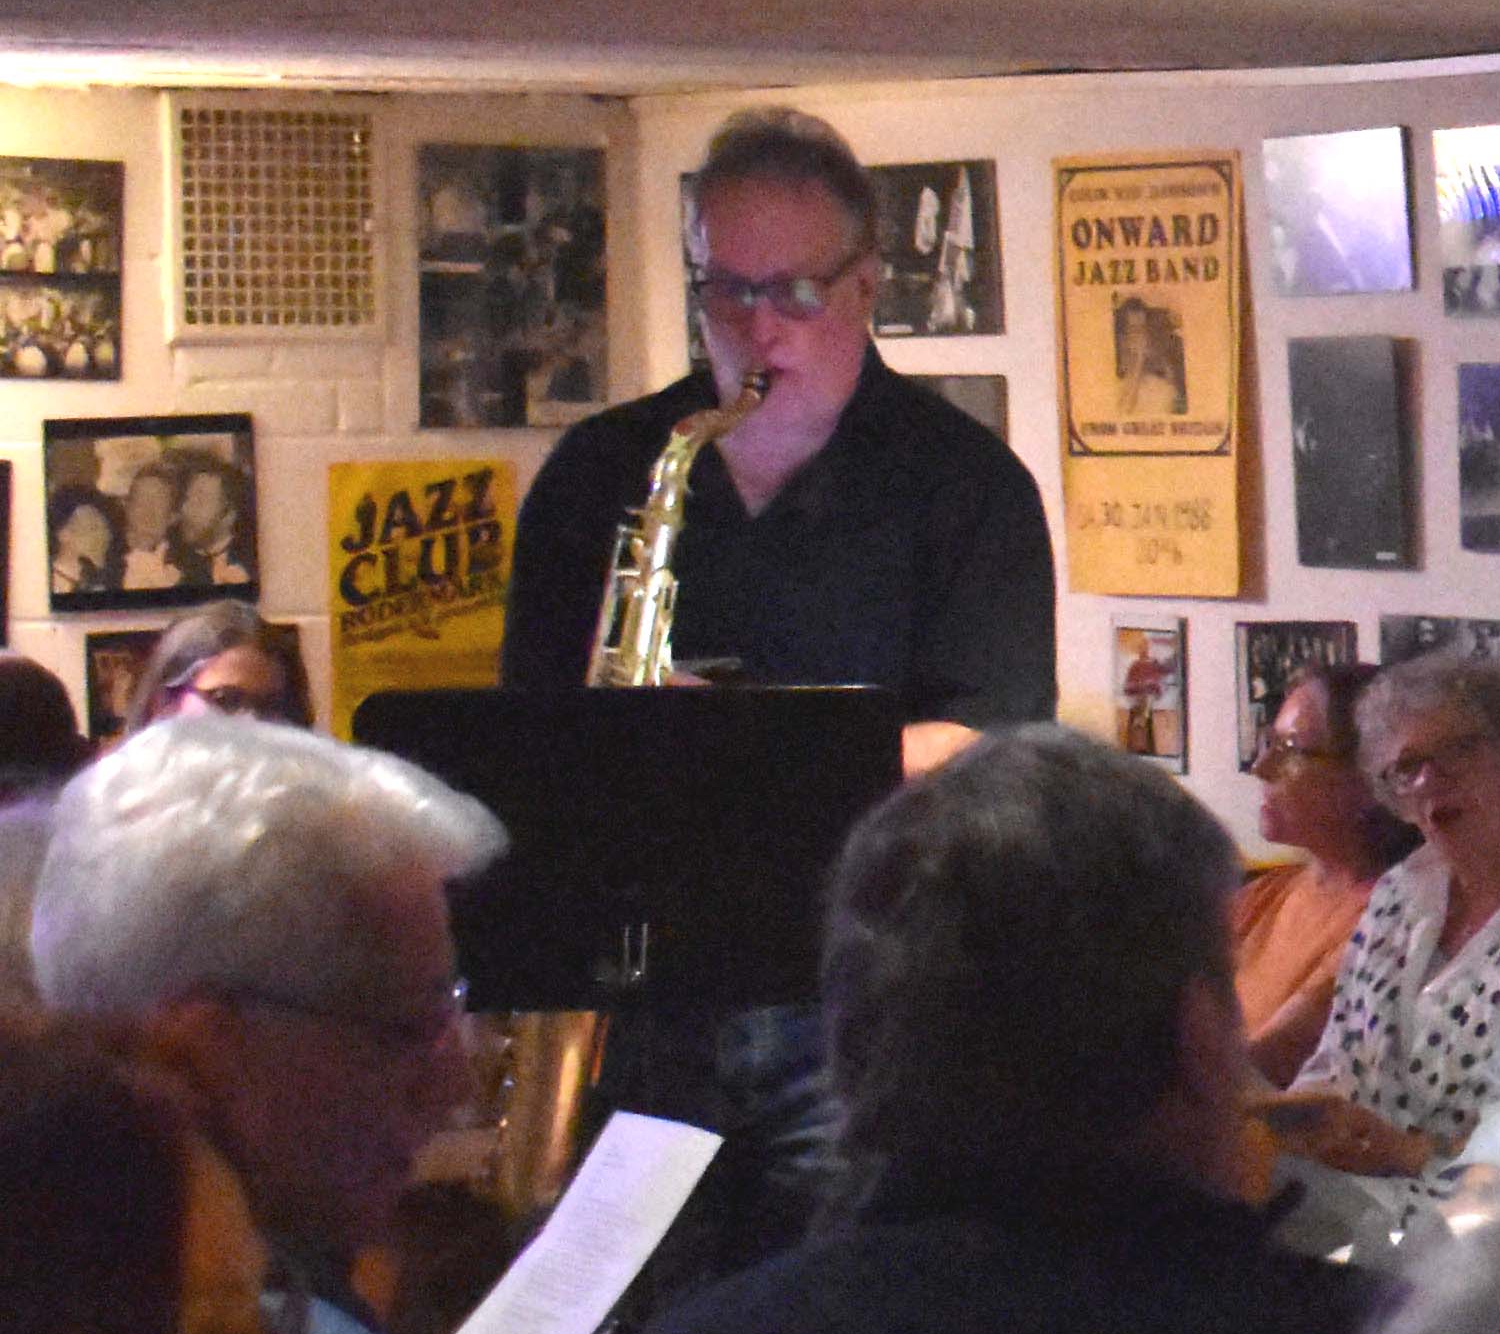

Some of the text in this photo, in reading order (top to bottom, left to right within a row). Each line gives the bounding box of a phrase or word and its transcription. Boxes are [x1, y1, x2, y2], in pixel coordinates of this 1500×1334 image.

[1071, 212, 1220, 250] ONWARD
[1072, 255, 1220, 287] JAZZ BAND
[341, 466, 496, 552] JAZZ
[340, 520, 502, 605] CLUB
